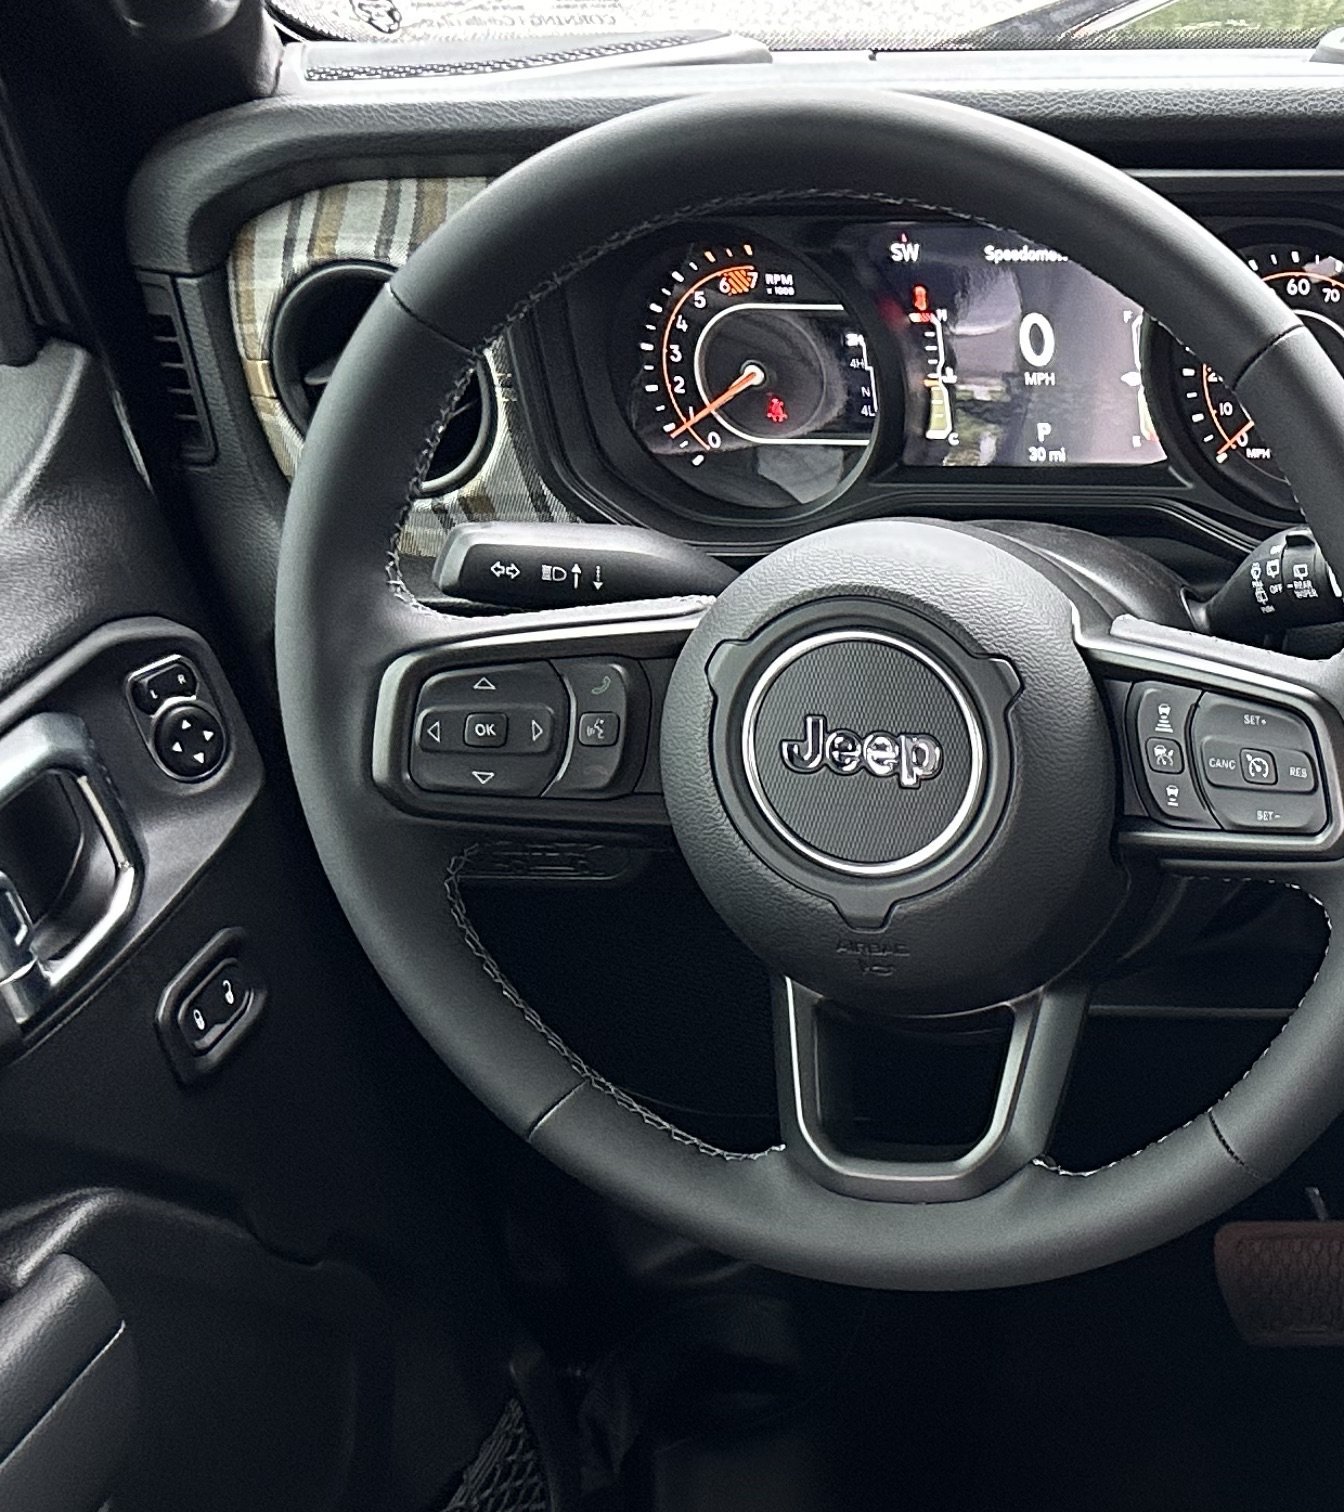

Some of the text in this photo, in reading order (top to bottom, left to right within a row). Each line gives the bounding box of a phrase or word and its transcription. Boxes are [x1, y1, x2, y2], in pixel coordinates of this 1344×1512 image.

[890, 243, 920, 262] SW
[719, 277, 731, 293] 6
[747, 272, 758, 288] 7
[765, 274, 793, 286] RPM
[1286, 278, 1310, 296] 60
[694, 291, 706, 308] 5
[1322, 288, 1340, 302] 70
[676, 315, 688, 332] 4
[1019, 312, 1055, 366] 0
[669, 345, 682, 362] 3
[850, 358, 865, 369] 4H
[673, 376, 685, 394] 2
[1024, 372, 1055, 386] MPH
[861, 386, 871, 397] N
[861, 404, 876, 417] 4L
[1219, 402, 1233, 416] 10
[1036, 422, 1052, 442] P
[708, 432, 721, 449] 0
[1029, 447, 1066, 462] 30 mi
[178, 674, 186, 684] R
[475, 723, 496, 737] OK
[782, 715, 943, 788] Jeep
[1209, 758, 1236, 770] CANC
